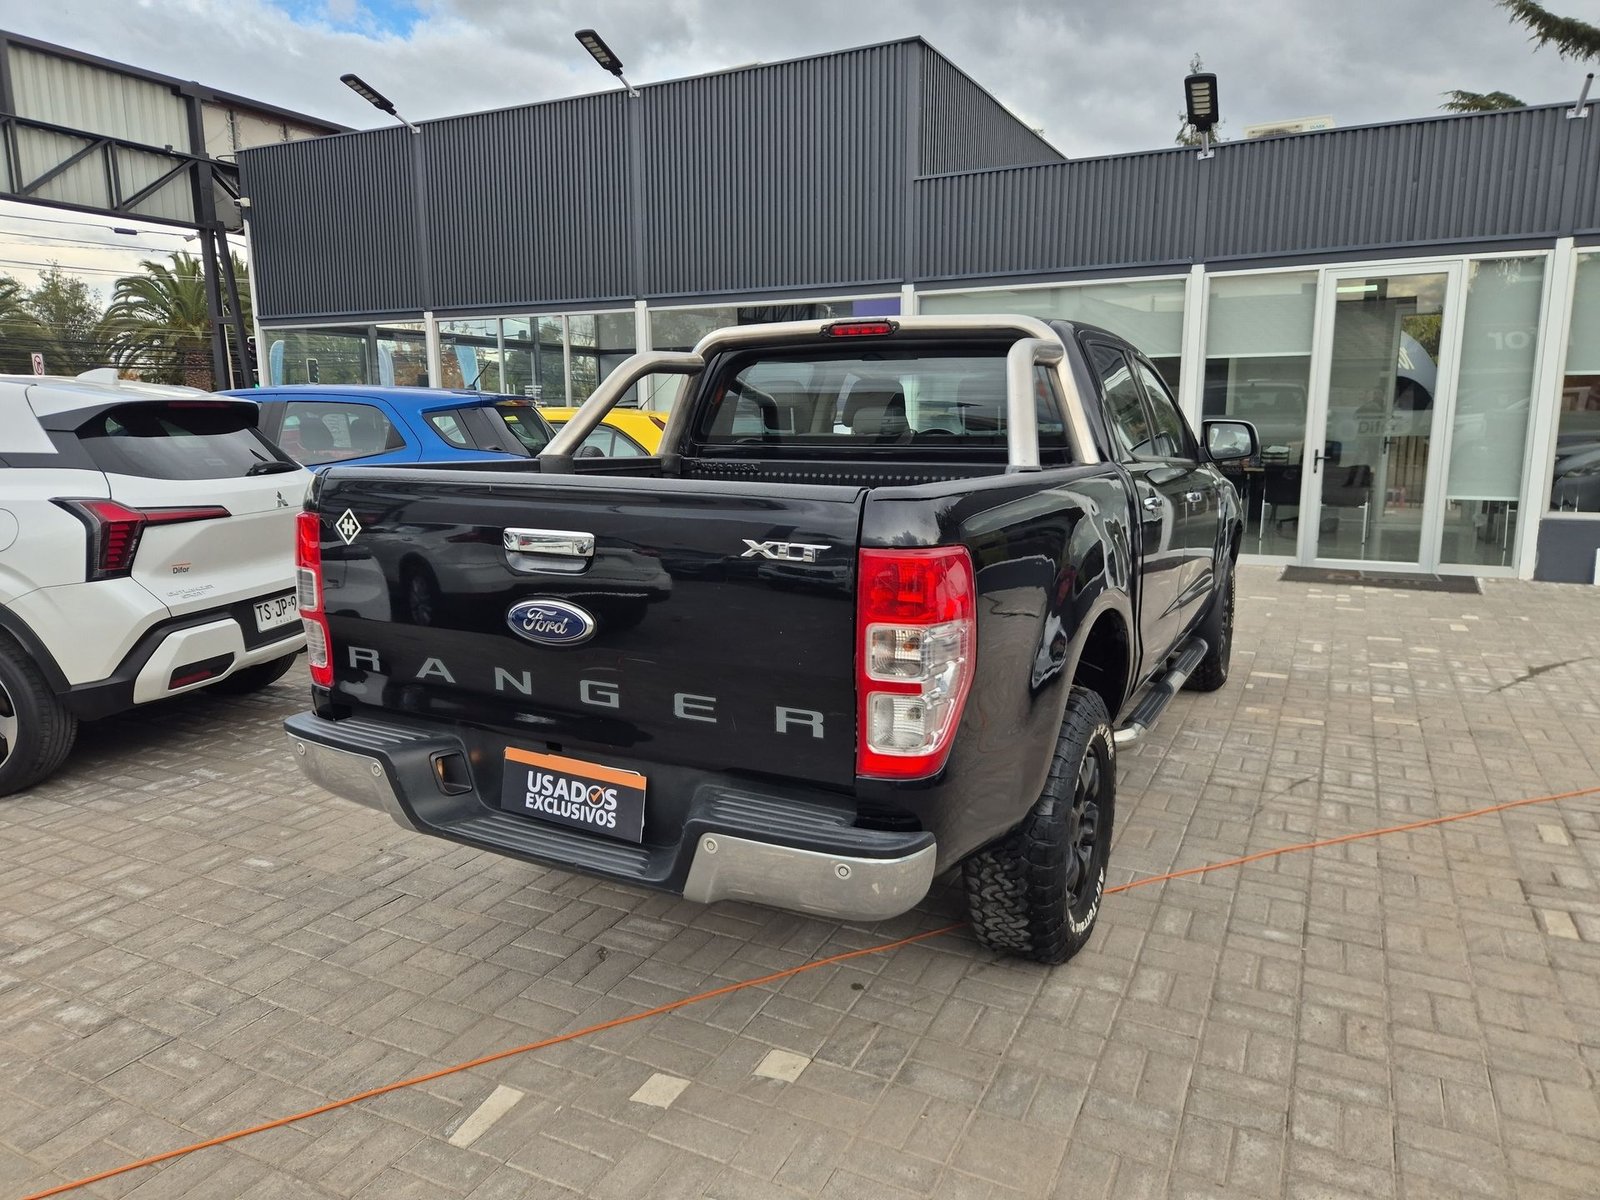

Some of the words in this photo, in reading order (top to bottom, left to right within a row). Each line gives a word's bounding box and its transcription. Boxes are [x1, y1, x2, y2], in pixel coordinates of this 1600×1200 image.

[741, 539, 832, 562] XLT
[172, 566, 190, 574] Difor
[523, 606, 568, 635] Ford
[348, 646, 824, 738] RANGER
[527, 770, 618, 812] USADOS
[525, 791, 617, 829] EXCLUSIVOS
